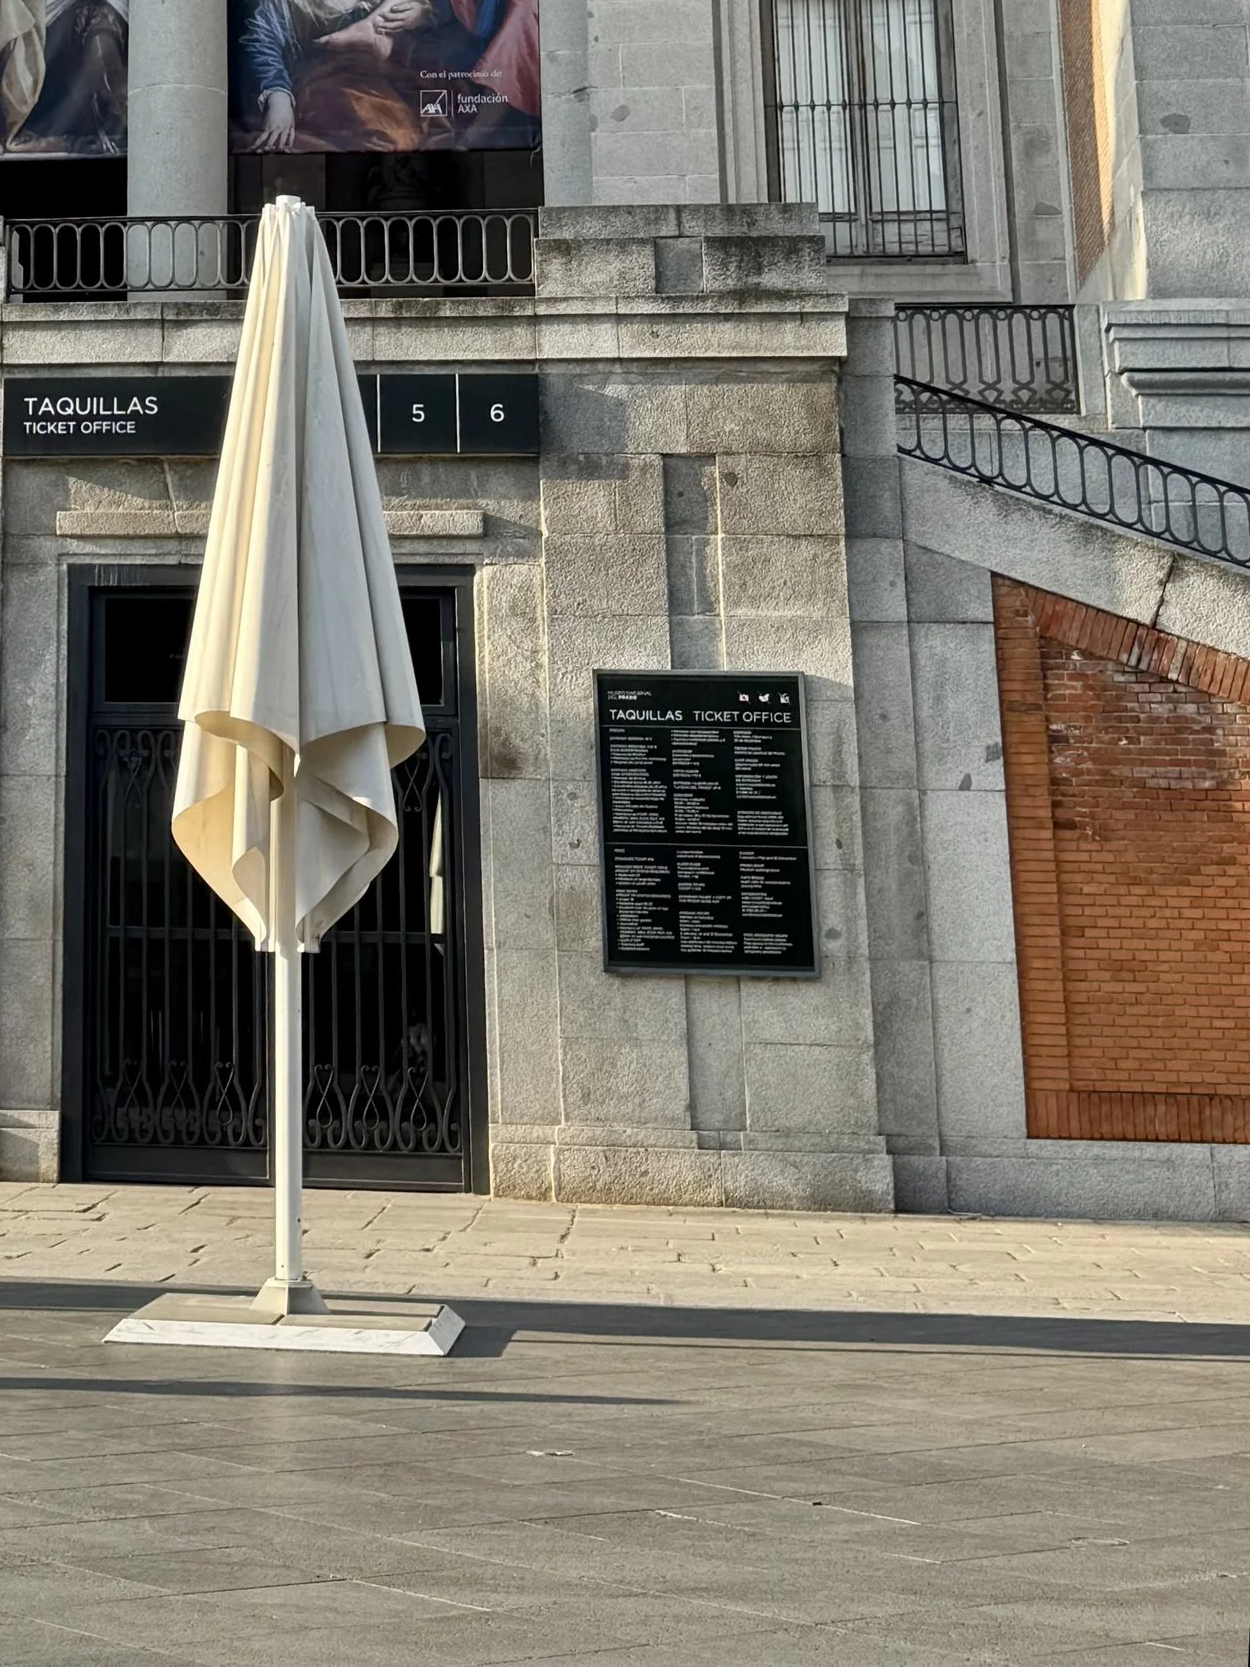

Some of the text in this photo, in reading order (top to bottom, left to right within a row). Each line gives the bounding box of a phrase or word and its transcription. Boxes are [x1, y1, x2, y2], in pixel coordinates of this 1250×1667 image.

[420, 70, 438, 79] Con
[438, 70, 447, 78] el
[457, 92, 509, 104] fundación
[457, 104, 478, 114] AXA
[23, 396, 159, 416] TAQUILLAS
[490, 404, 505, 422] 6
[412, 404, 425, 423] 5
[23, 421, 136, 434] TICKET OFFICE
[609, 709, 792, 724] TAQUILLAS TICKET OFFICE
